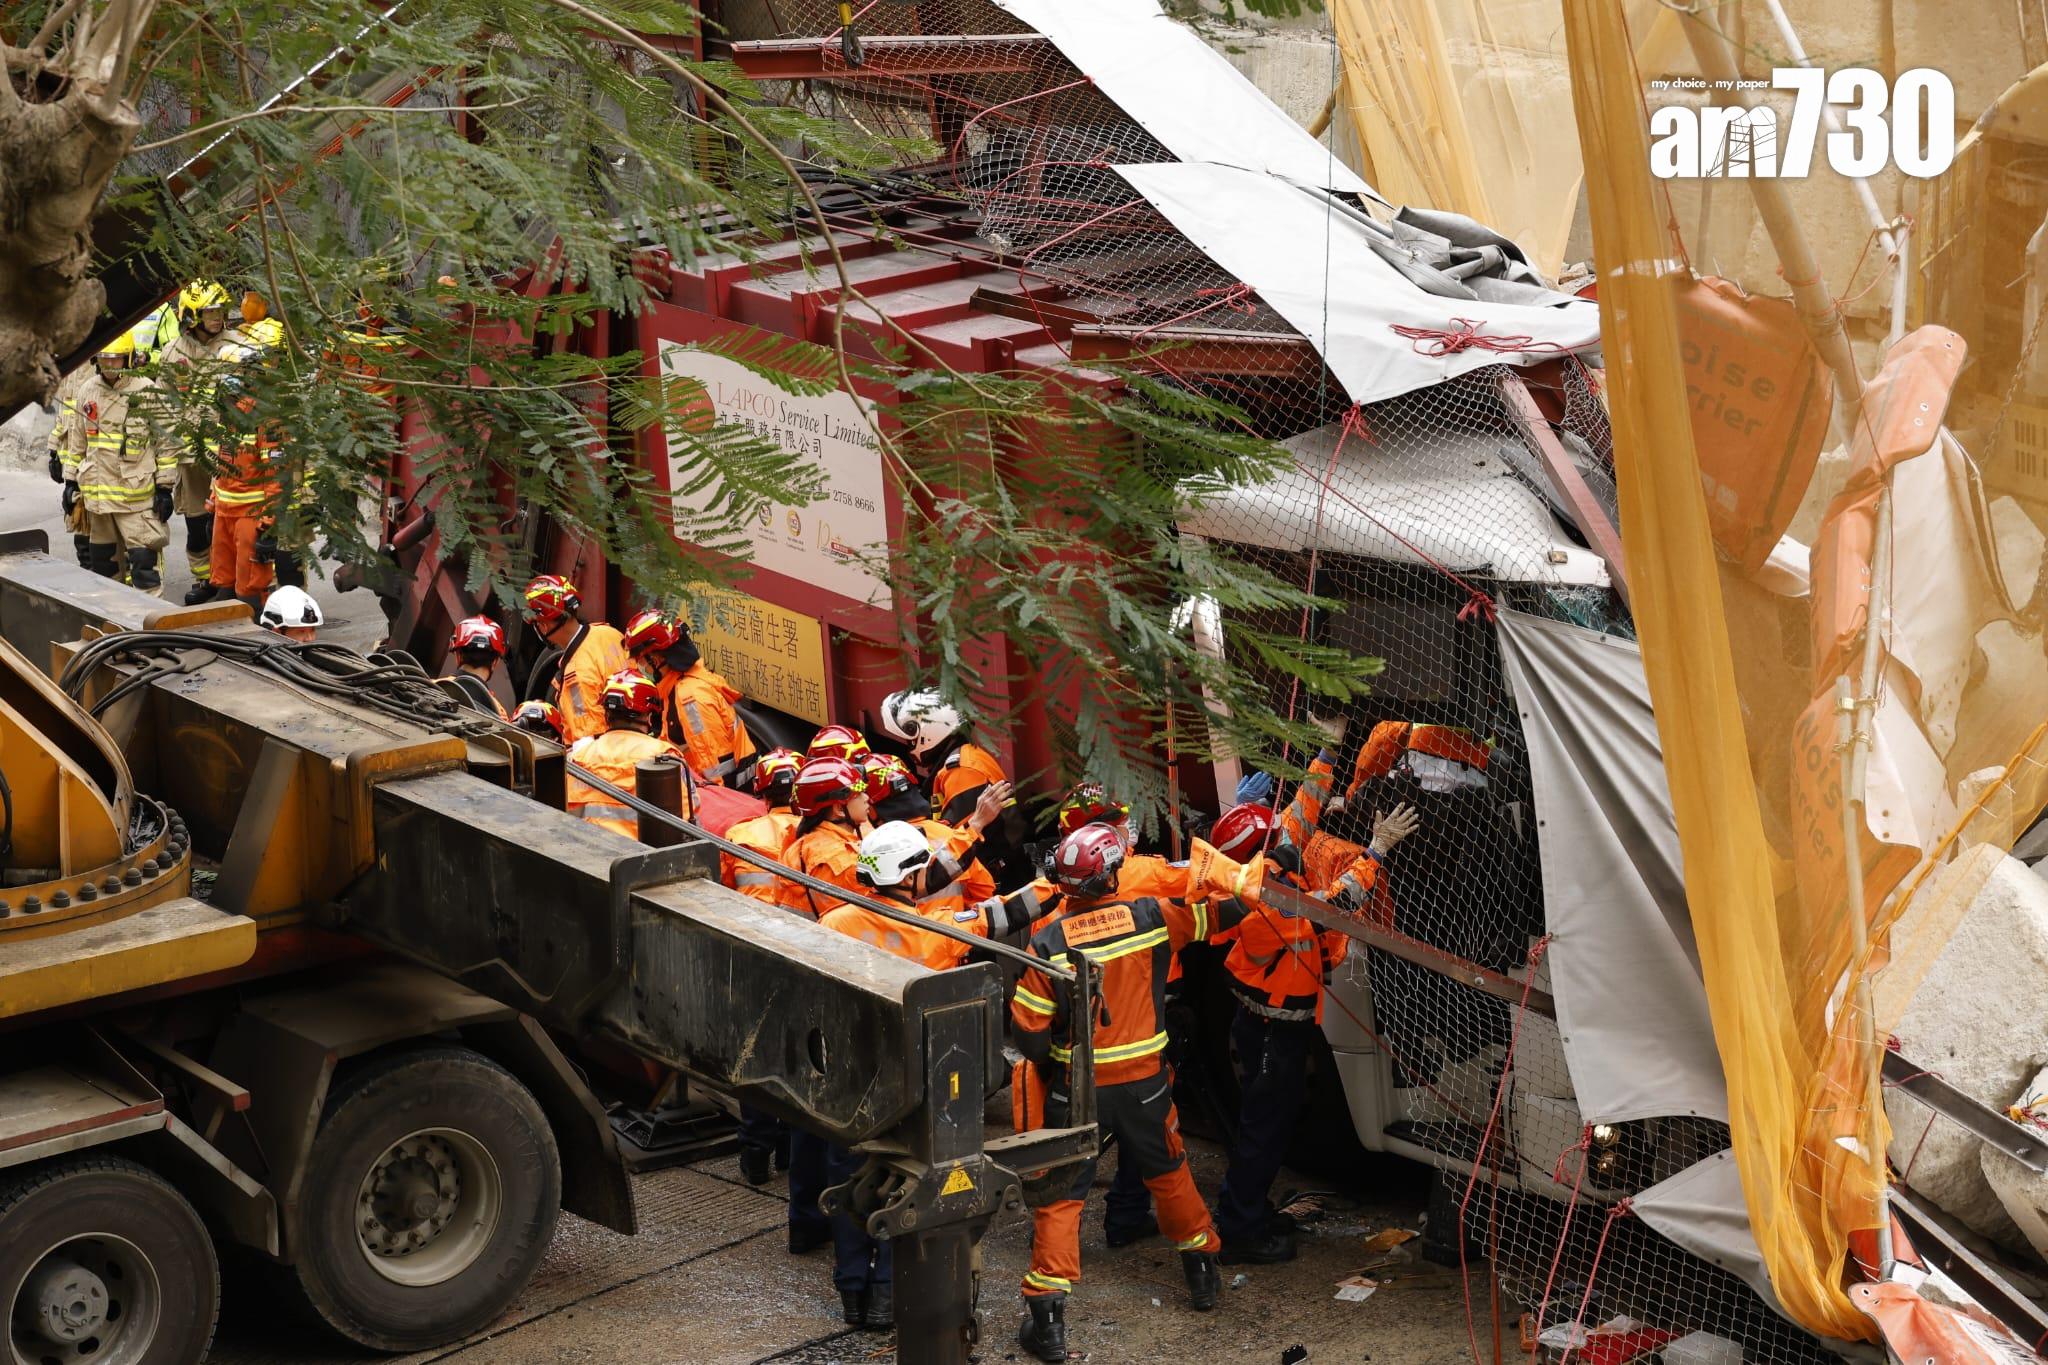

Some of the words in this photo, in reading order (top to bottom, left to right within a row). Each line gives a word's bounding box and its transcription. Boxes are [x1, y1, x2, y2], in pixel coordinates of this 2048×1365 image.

[1681, 339, 1776, 402] oise
[717, 382, 776, 419] LAPCO
[778, 400, 820, 434] Service
[824, 413, 875, 450] Limited
[833, 489, 853, 506] 2758
[854, 496, 875, 513] 8666
[693, 638, 821, 718] 收集服務承辦商
[950, 1073, 959, 1094] 1
